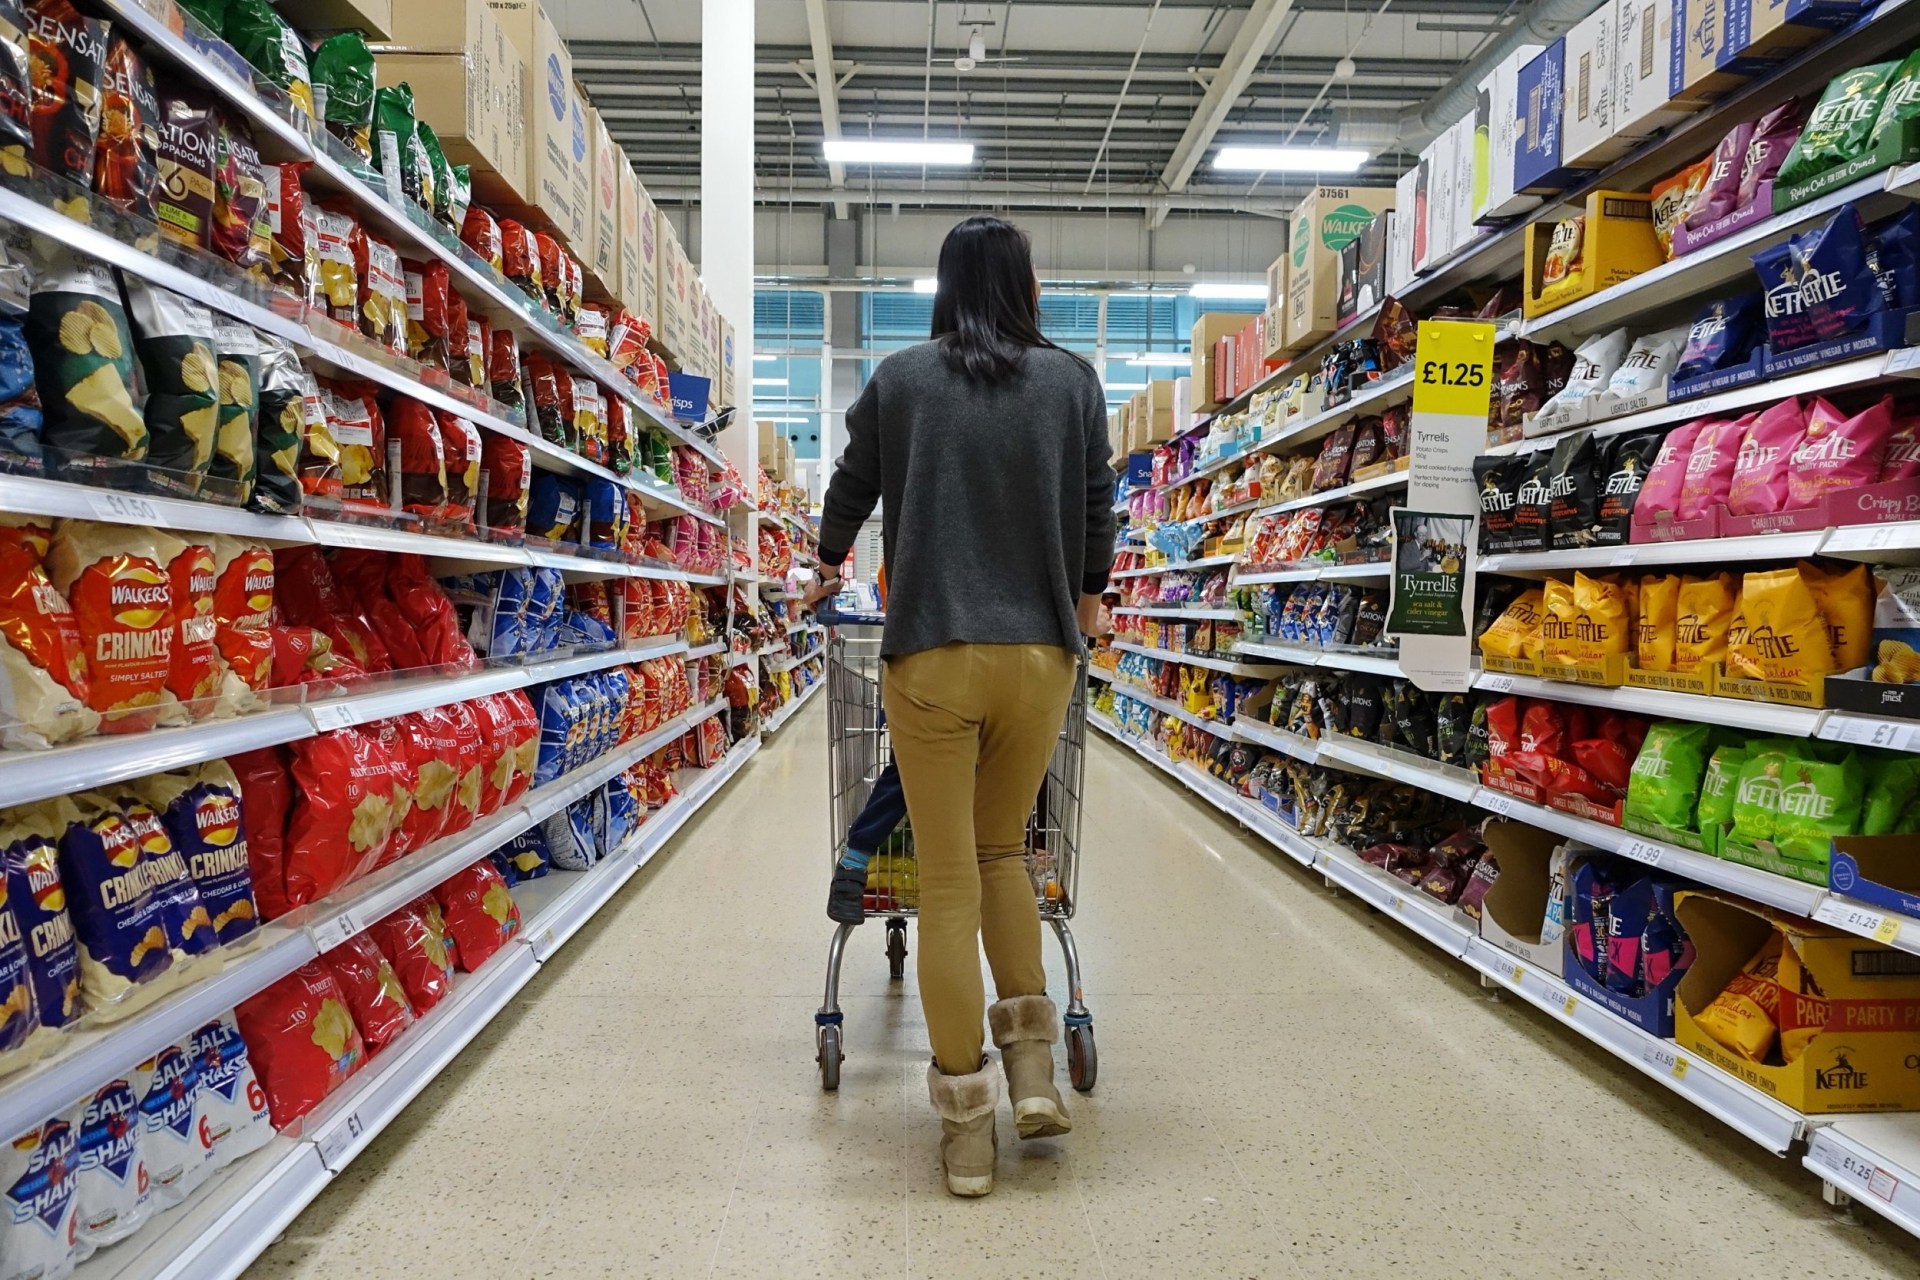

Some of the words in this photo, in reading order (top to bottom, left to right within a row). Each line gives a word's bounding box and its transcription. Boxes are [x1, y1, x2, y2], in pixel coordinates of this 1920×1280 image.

[1622, 1, 1633, 48] KETTLE
[1599, 84, 1608, 129] KETTLE
[1811, 93, 1879, 126] KETTLE
[1789, 184, 1811, 201] Ridge
[1810, 177, 1827, 192] Cut
[1849, 155, 1877, 176] Crunch
[1319, 188, 1349, 199] 37561
[1686, 231, 1703, 245] Ridge
[1702, 226, 1715, 238] Cut
[1731, 207, 1754, 224] Crunch
[1764, 364, 1775, 374] SEA
[1775, 361, 1787, 372] SALT
[1794, 353, 1819, 366] BALSAMIC
[1820, 346, 1843, 360] VINEGAR
[1843, 343, 1851, 354] OF
[1852, 336, 1877, 350] MODENA
[1422, 361, 1484, 388] £1.25
[1676, 387, 1686, 397] SALT
[1711, 377, 1730, 388] VINEGAR
[1730, 375, 1737, 384] OF
[1737, 370, 1757, 381] MODENA
[1610, 402, 1629, 415] LIGHTLY
[1630, 397, 1648, 410] SALTED
[1417, 430, 1450, 443] Tyrrells
[1818, 460, 1839, 469] PACK
[106, 494, 156, 520] £1.50
[1857, 493, 1902, 513] Crispy
[1777, 515, 1795, 528] PACK
[1884, 512, 1905, 521] MAPLE
[1670, 526, 1686, 537] PACK
[111, 585, 170, 605] WALKERS
[1423, 610, 1449, 618] vinegar
[96, 624, 174, 662] CRINKLES
[110, 672, 139, 682] SIMPLY
[140, 670, 168, 680] SALTED
[1543, 666, 1558, 677] MATURE
[1582, 671, 1591, 680] RED
[1591, 672, 1605, 681] ONION
[1629, 674, 1647, 684] MATURE
[1676, 678, 1688, 688] RED
[1688, 679, 1705, 690] ONION
[1491, 679, 1512, 690] £1.99
[1719, 682, 1740, 693] MATURE
[1769, 687, 1775, 698] &
[1775, 688, 1789, 699] RED
[1791, 690, 1812, 702] ONION
[1880, 692, 1904, 704] finest
[339, 704, 355, 724] £1
[1870, 724, 1900, 746] £1
[347, 784, 359, 797] 10
[1487, 799, 1510, 812] £1.99
[1777, 785, 1835, 819] KETTLE
[196, 804, 240, 830] WALKERS
[1598, 808, 1616, 823] CREAM
[512, 835, 527, 849] 10
[190, 840, 249, 881] CRINKLES
[1628, 842, 1661, 863] £1.99
[1802, 866, 1827, 883] ONION
[202, 884, 233, 899] CHEDDAR
[466, 890, 479, 901] 10
[337, 913, 357, 936] £1
[1848, 912, 1879, 930] £1.25
[1501, 961, 1515, 976] £1.50
[1551, 990, 1567, 1006] £1.50
[290, 1009, 307, 1023] 10
[1846, 1006, 1897, 1026] PARTY
[190, 1022, 234, 1057] SALT
[1655, 1050, 1674, 1068] £1.50
[1695, 1041, 1715, 1062] MATURE
[1715, 1054, 1738, 1076] CHEDDAR
[1746, 1069, 1758, 1083] RED
[1758, 1075, 1777, 1094] ONION
[1815, 1066, 1869, 1090] KETTLE
[84, 1084, 137, 1127] SALT
[246, 1079, 266, 1112] 6
[198, 1114, 213, 1149] 6
[348, 1112, 363, 1141] £1
[29, 1127, 78, 1174] SALT
[1843, 1156, 1872, 1180] £1.25
